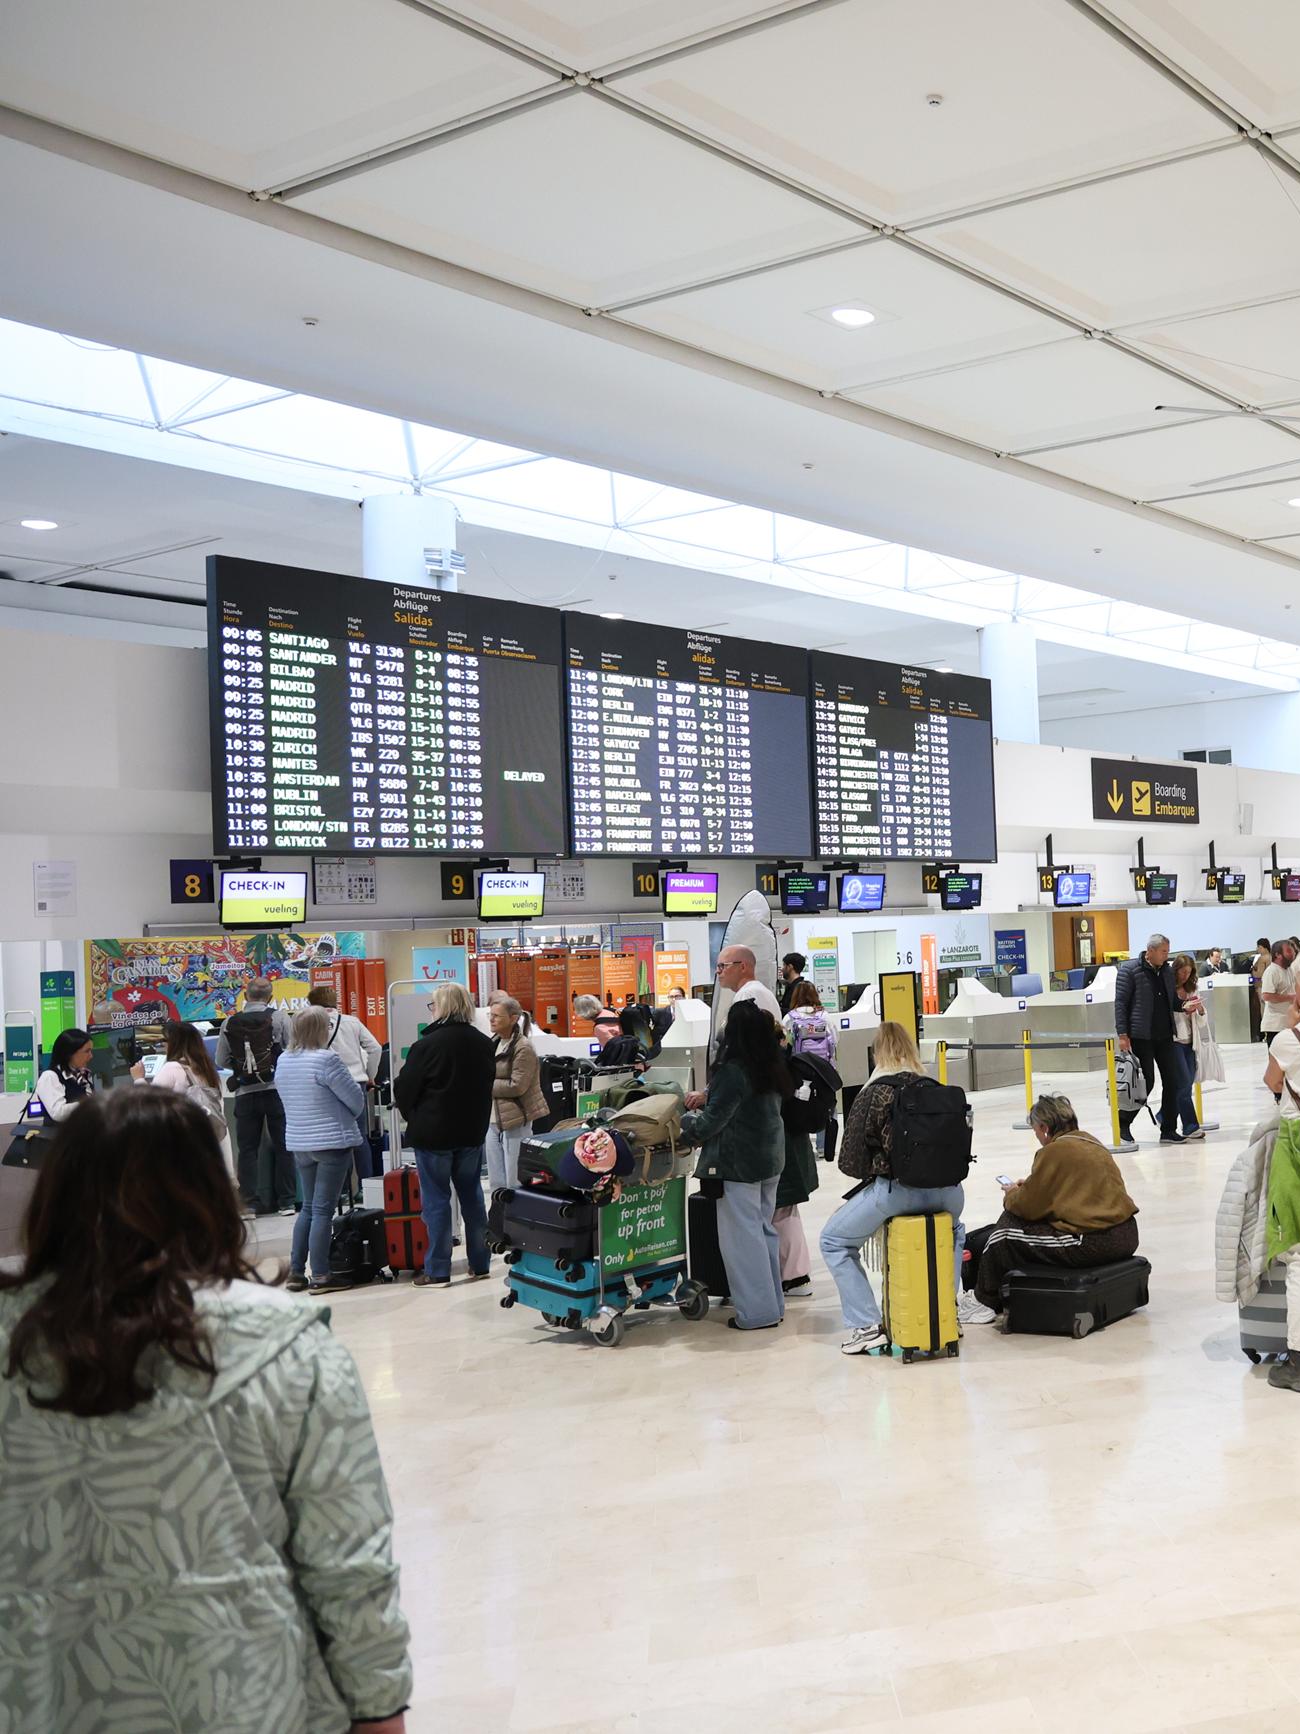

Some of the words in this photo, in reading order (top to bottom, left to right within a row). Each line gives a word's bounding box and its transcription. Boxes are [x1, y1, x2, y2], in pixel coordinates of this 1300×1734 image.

[393, 587, 441, 603] Departures
[223, 600, 237, 608] Time
[393, 598, 428, 614] Abflüge
[223, 607, 243, 616] Stunde
[268, 606, 299, 616] Destination
[223, 614, 240, 623] Hora
[268, 620, 294, 630] Destino
[347, 616, 362, 625] Flight
[394, 611, 433, 627] Salidas
[347, 630, 365, 638] Vuelo
[687, 631, 721, 645] Departures
[223, 627, 262, 641] 09:05
[269, 632, 329, 649] SANTIAGO
[349, 642, 370, 655] VLG
[687, 641, 712, 653] Abflüge
[223, 643, 263, 657] 09:05
[270, 648, 337, 666] SANTANDER
[224, 659, 263, 673] 09:20
[270, 664, 315, 678] BILBAO
[350, 672, 371, 685] VLG
[901, 667, 927, 678] Departures
[224, 675, 264, 688] 09:25
[270, 679, 316, 694] MADRID
[350, 687, 365, 698] IB
[902, 685, 924, 696] Salidas
[224, 691, 264, 704] 09:25
[271, 695, 316, 709] MADRID
[351, 702, 372, 714] QTR
[571, 696, 598, 708] 11:50
[815, 699, 835, 711] 13:25
[225, 707, 264, 720] 09:25
[271, 710, 316, 725] MADRID
[351, 717, 373, 729] VLG
[225, 723, 265, 736] 09:25
[272, 726, 317, 740] MADRID
[352, 732, 373, 744] IBS
[816, 722, 836, 733] 13:35
[226, 739, 265, 751] 10:30
[272, 742, 317, 755] ZURICH
[572, 736, 599, 747] 12:15
[226, 755, 266, 767] 10:35
[272, 758, 318, 771] NANTES
[352, 763, 374, 773] EJU
[450, 767, 481, 779] 11:35
[504, 770, 545, 783] DELAYED
[573, 762, 600, 773] 12:35
[227, 771, 266, 783] 10:35
[273, 774, 340, 787] AMSTERDAM
[353, 777, 368, 788] HV
[227, 787, 267, 799] 10:40
[273, 789, 318, 801] DUBLIN
[353, 792, 369, 803] FR
[1154, 782, 1187, 800] Boarding
[228, 803, 267, 814] 11:00
[274, 804, 326, 817] BRISTOL
[353, 807, 375, 818] EZY
[1155, 801, 1195, 818] Embarque
[228, 819, 268, 830] 11:05
[274, 820, 349, 834] LONDON/STN
[354, 822, 370, 833] FR
[451, 824, 483, 835] 10:35
[228, 835, 268, 847] 11:10
[275, 836, 327, 848] GATWICK
[354, 837, 376, 848] EZY
[184, 874, 201, 897] 8
[228, 880, 286, 891] CHECK-IN
[451, 874, 464, 895] 9
[486, 880, 529, 889] CHECK-IN
[637, 874, 655, 893] 10
[670, 878, 705, 888] PREMIUM
[760, 875, 774, 891] 11
[924, 876, 938, 890] 12
[1041, 875, 1053, 889] 13
[1135, 875, 1146, 888] 14
[1207, 876, 1216, 887] 15
[1272, 876, 1281, 888] 16
[512, 900, 538, 911] vueling
[691, 897, 713, 907] vueling
[264, 904, 298, 916] vueling
[946, 944, 979, 954] LANZAROTE
[133, 958, 160, 969] ISLAS
[906, 951, 913, 965] 6
[997, 953, 1025, 961] CHECK-IN
[111, 962, 184, 985] CANARIAS
[442, 969, 456, 978] TUI
[539, 962, 565, 974] easyJet
[367, 996, 376, 1016] EXIT
[111, 1011, 149, 1021] Viñedos
[150, 1010, 162, 1018] de
[111, 1020, 124, 1028] La
[650, 1186, 667, 1200] pay
[620, 1209, 634, 1222] for
[636, 1202, 662, 1217] petrol
[617, 1226, 634, 1240] up
[636, 1215, 666, 1237] front
[604, 1252, 625, 1266] Only
[634, 1238, 678, 1255] AutoReisen.com
